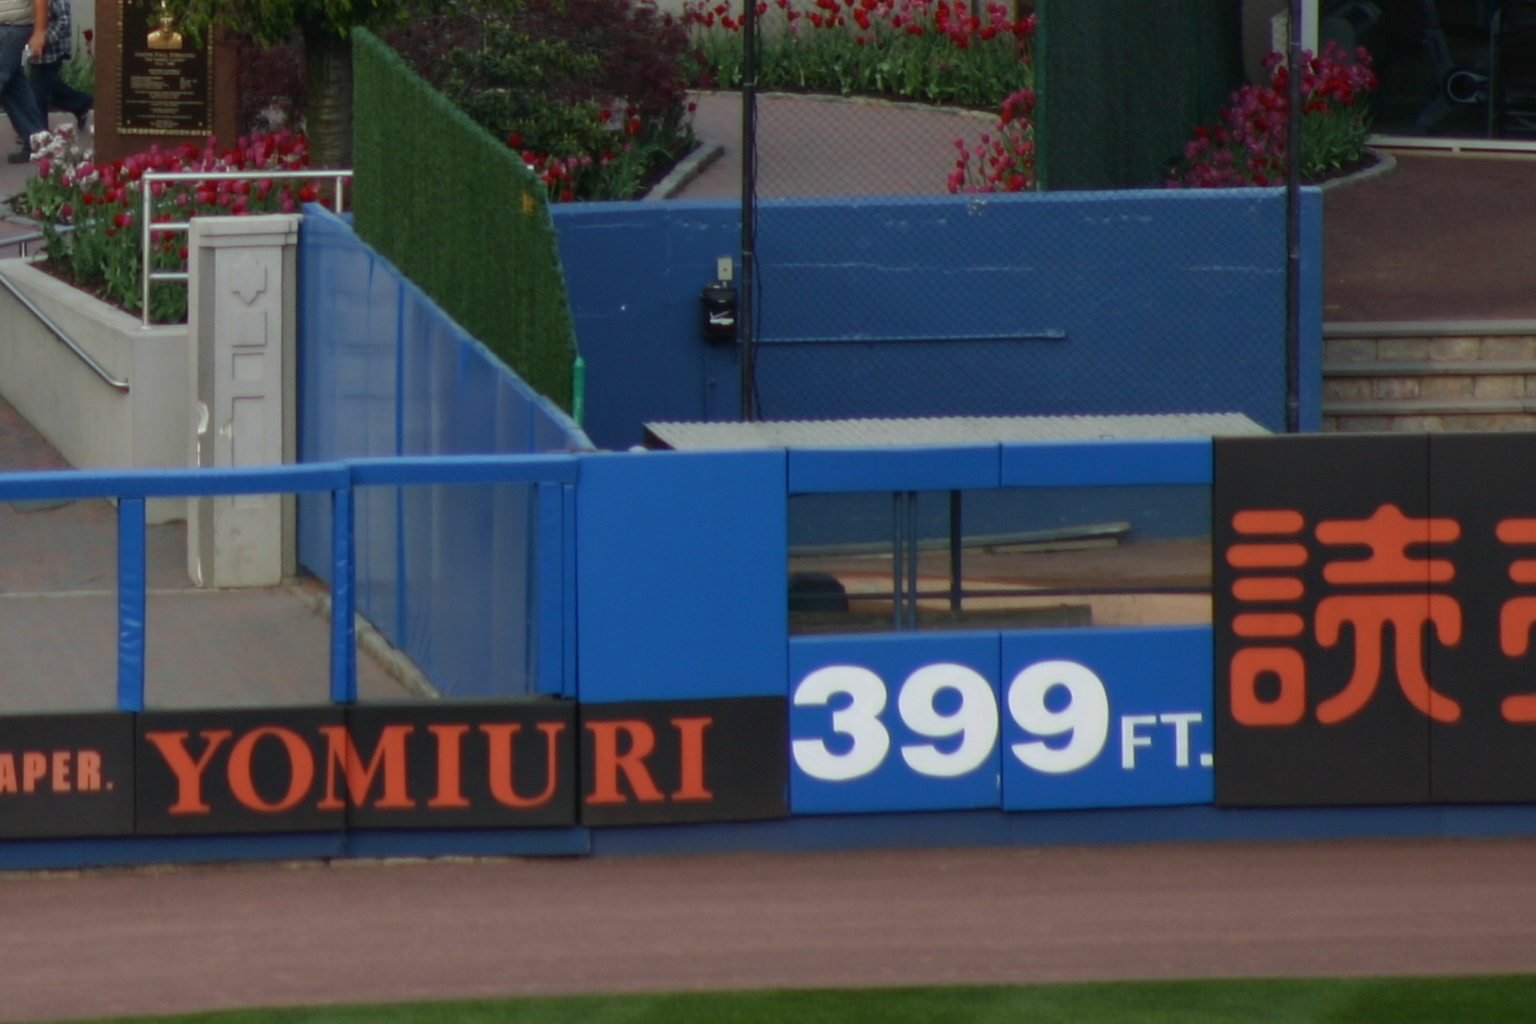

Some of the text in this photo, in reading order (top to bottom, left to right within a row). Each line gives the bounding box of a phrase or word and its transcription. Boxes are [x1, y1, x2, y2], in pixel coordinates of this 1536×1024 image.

[144, 716, 714, 815] YOMIURI
[790, 659, 1214, 780] 399 FT.
